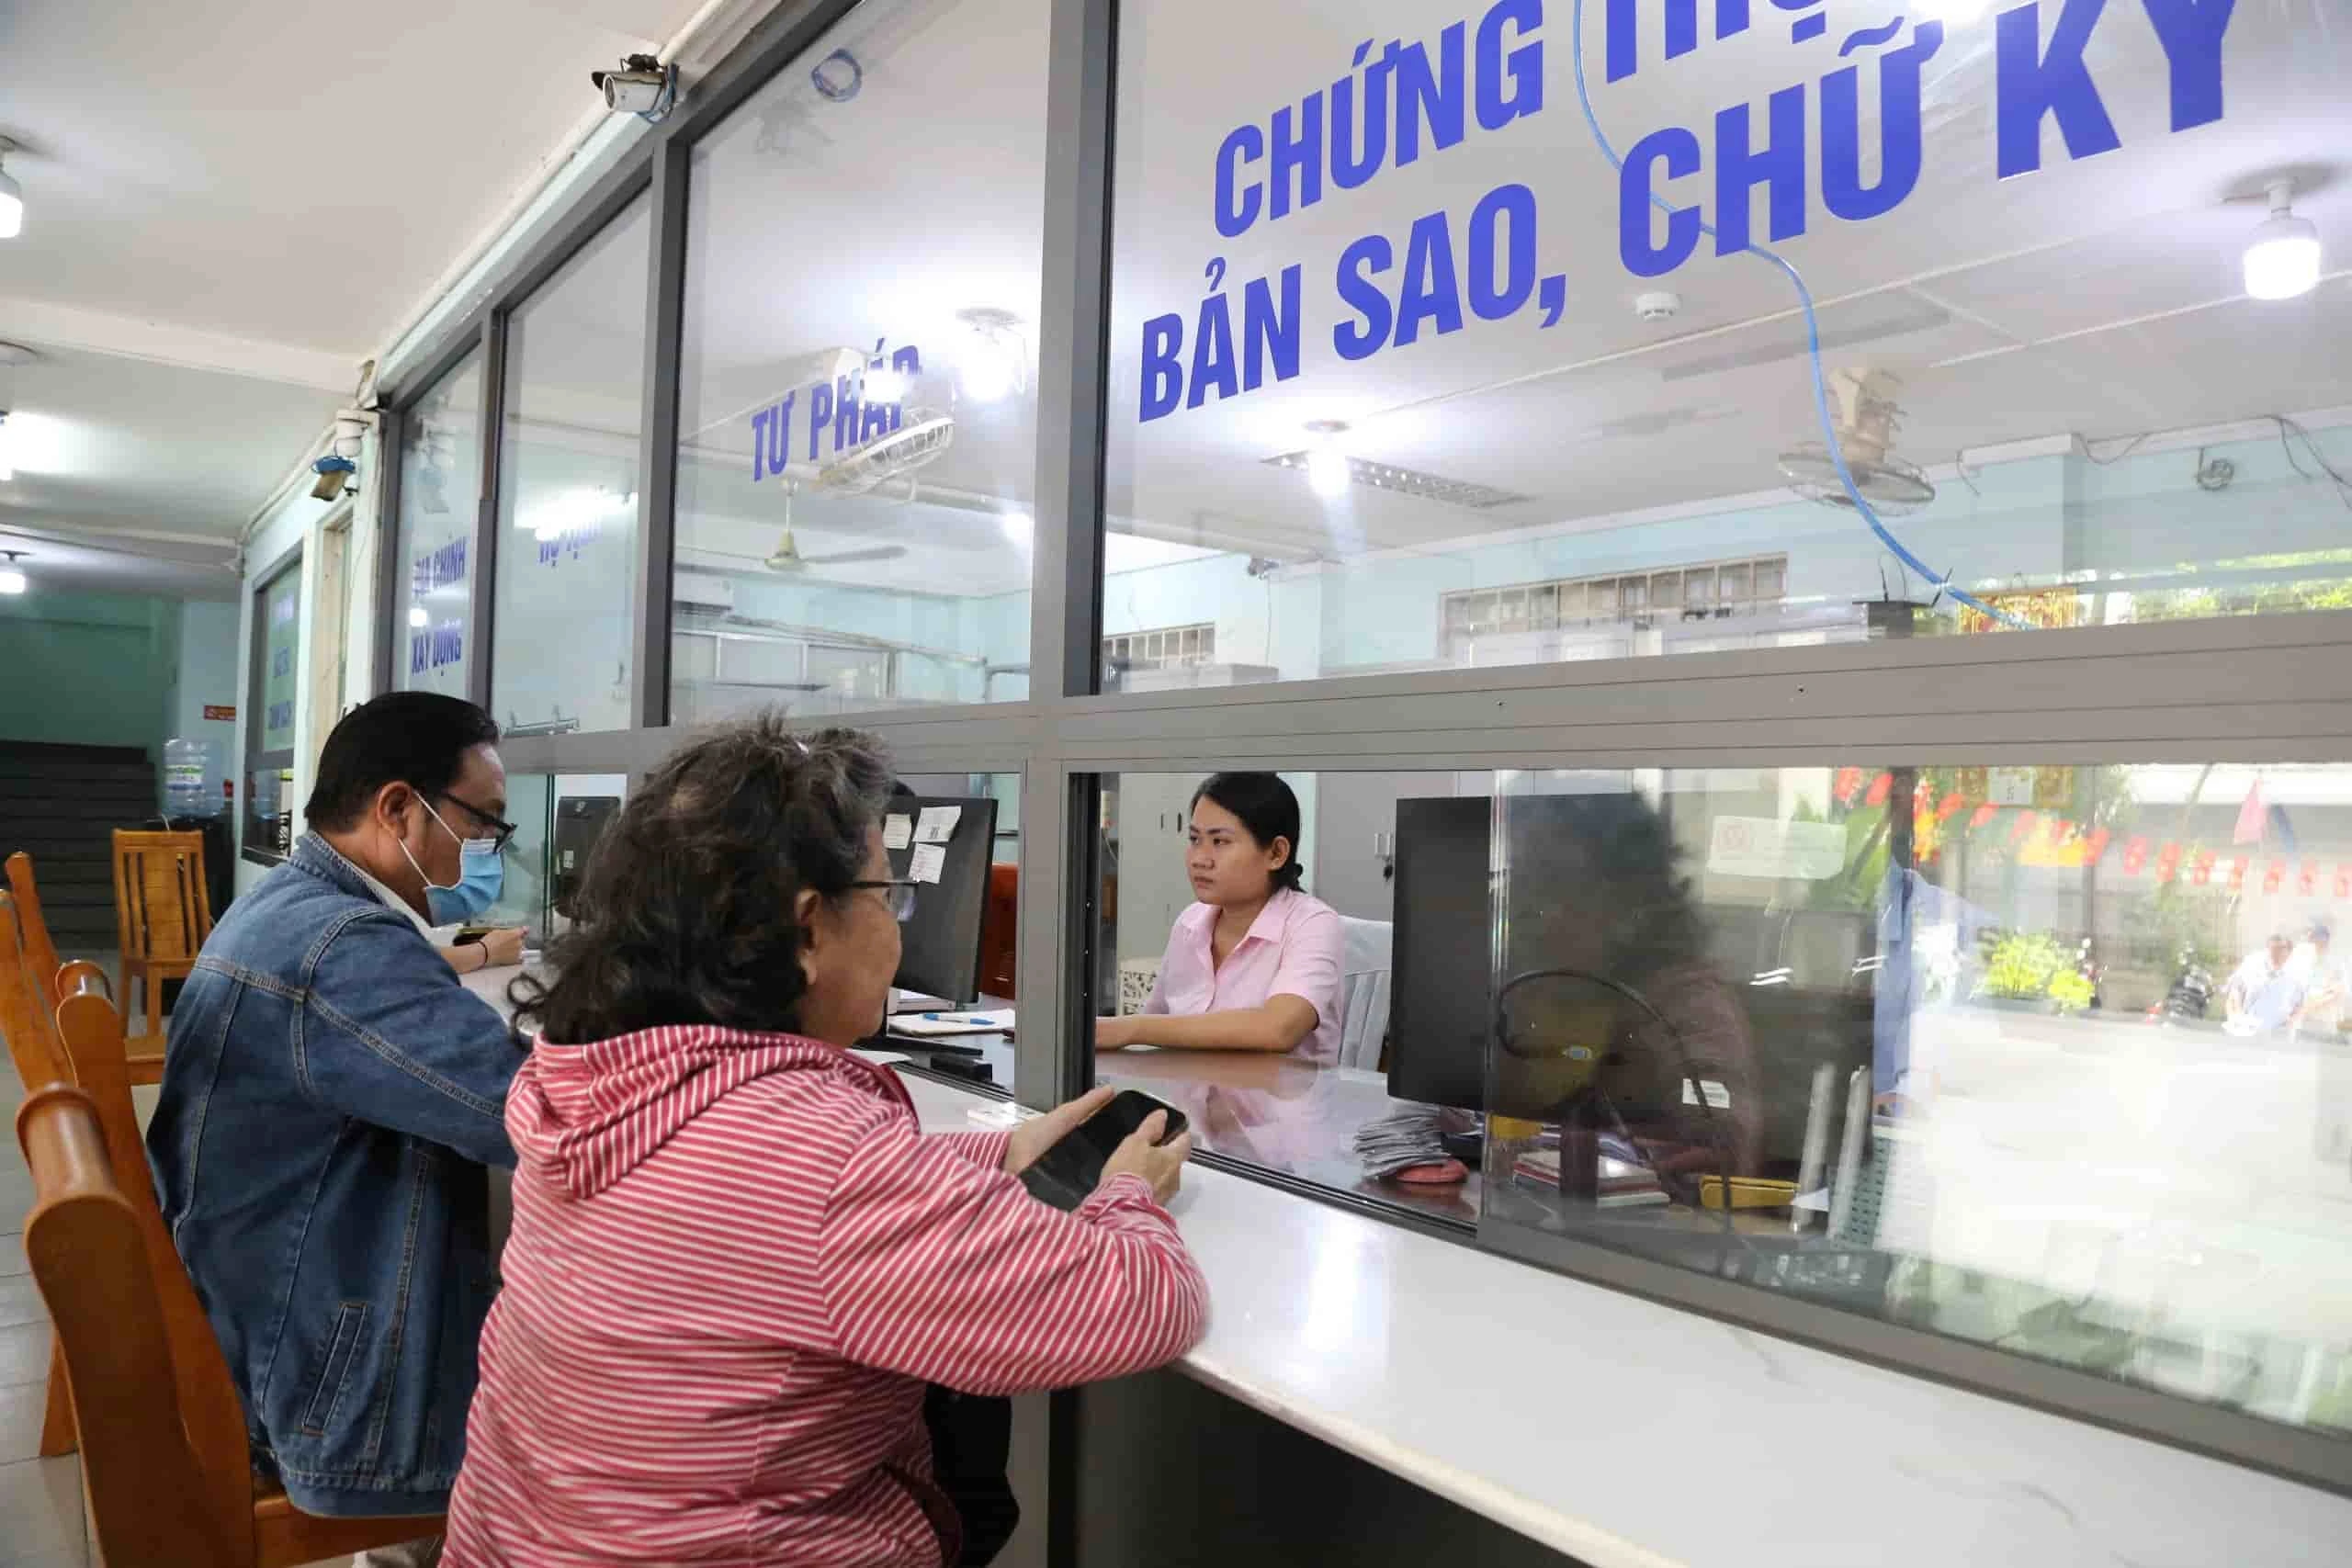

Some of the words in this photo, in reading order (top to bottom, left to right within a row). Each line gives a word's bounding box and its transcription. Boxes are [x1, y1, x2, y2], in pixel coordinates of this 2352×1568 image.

[1138, 256, 1302, 423] BẢN
[1333, 184, 1566, 361] SAO,
[1619, 17, 1944, 278] CHỮ
[1215, 0, 1544, 238] CHỨNG
